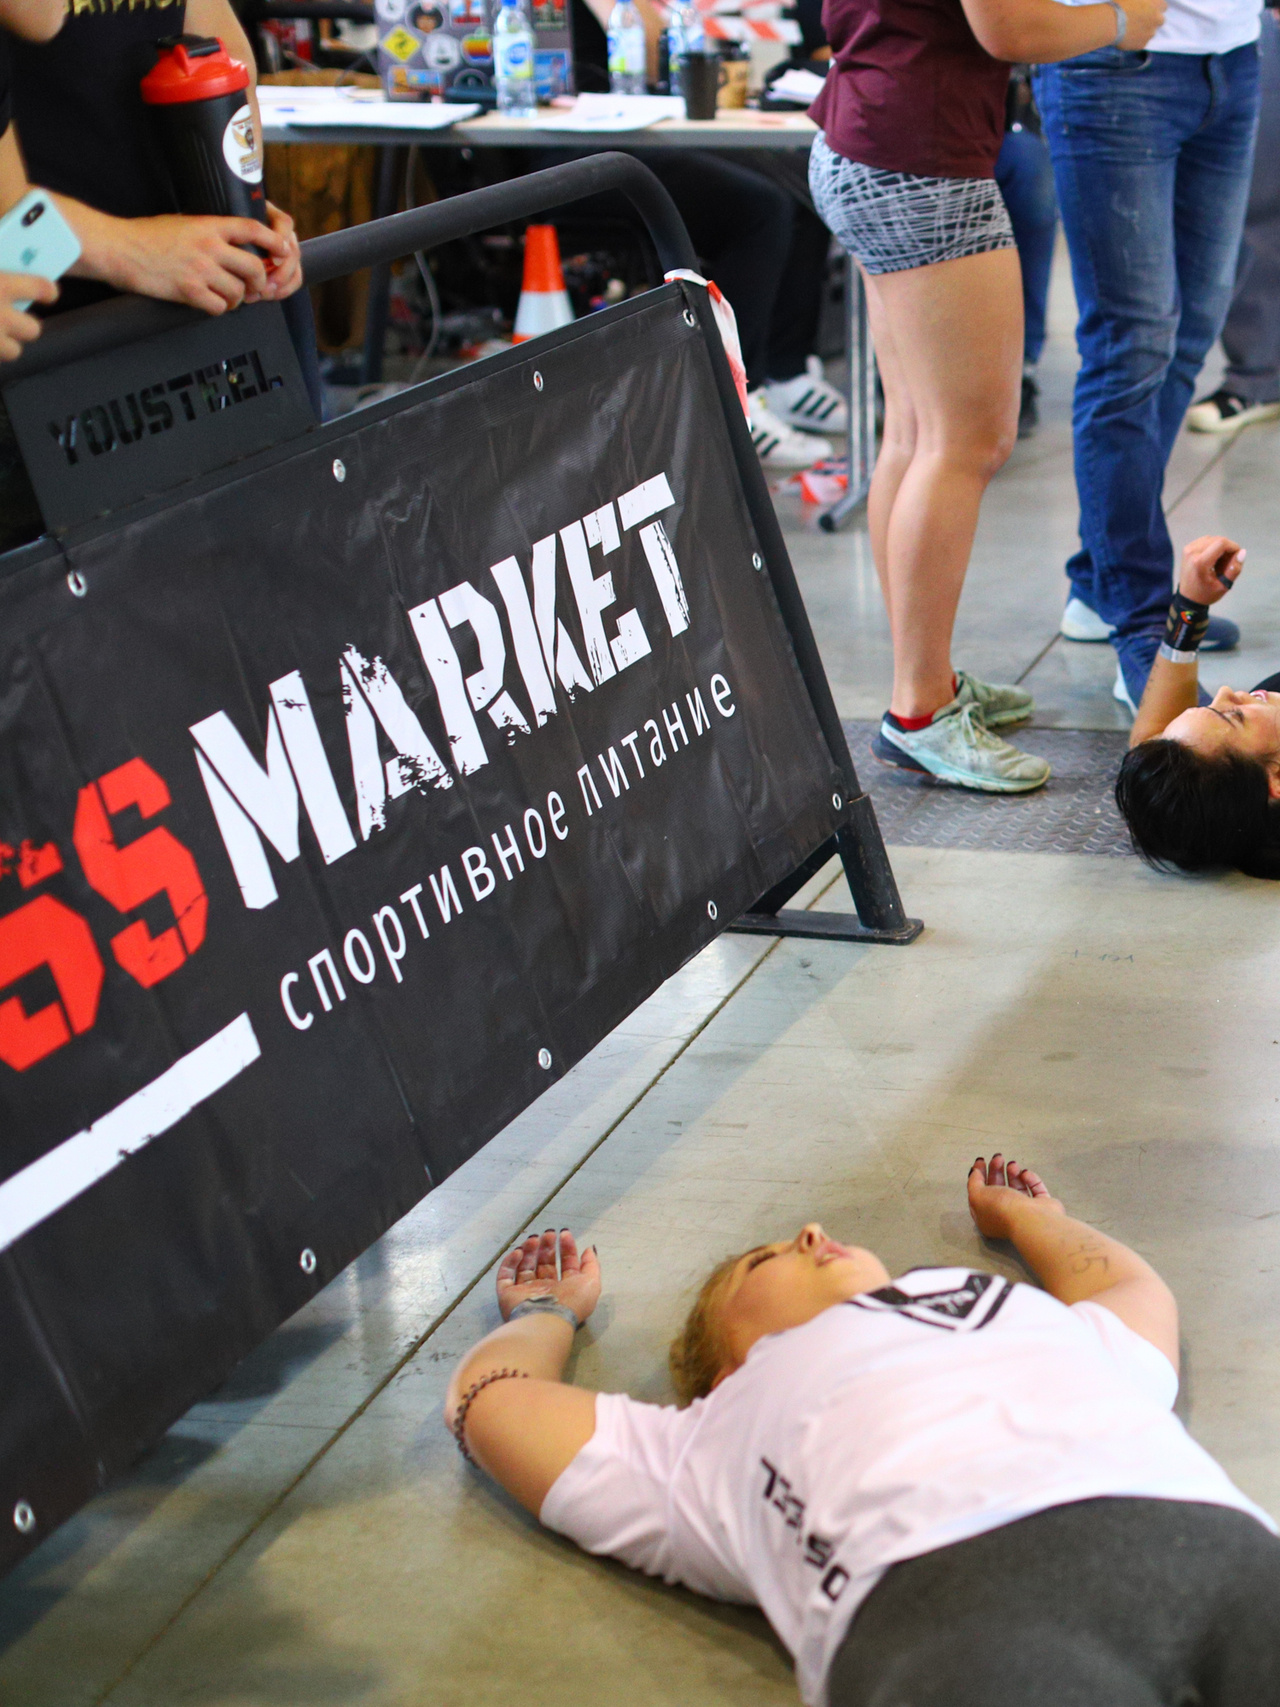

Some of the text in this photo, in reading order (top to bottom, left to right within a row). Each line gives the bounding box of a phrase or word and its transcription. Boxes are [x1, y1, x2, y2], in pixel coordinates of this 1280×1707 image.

[47, 350, 284, 467] YOUSTEEL
[280, 672, 737, 1032] спортивное питание
